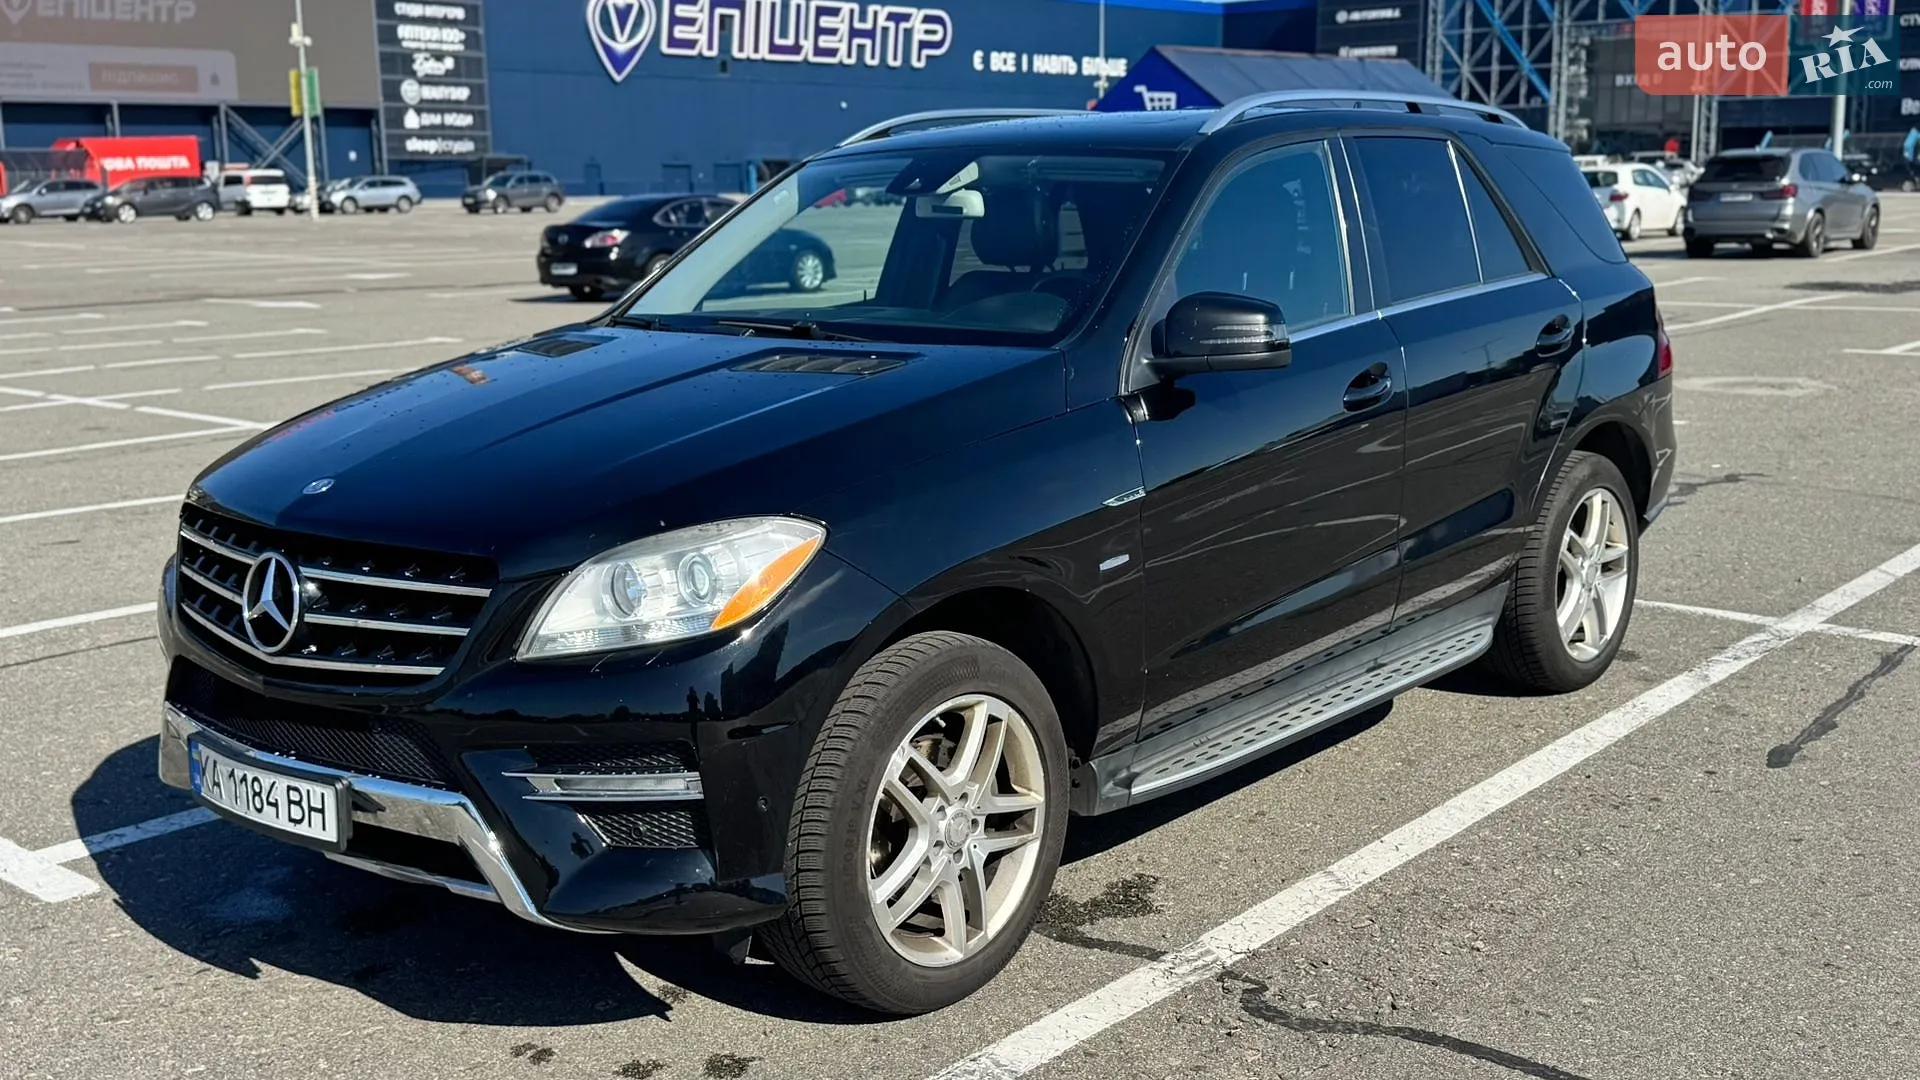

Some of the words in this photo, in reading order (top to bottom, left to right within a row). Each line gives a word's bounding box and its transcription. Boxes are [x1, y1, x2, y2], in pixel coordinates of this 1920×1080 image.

[36, 0, 198, 24] ЕПІЦЕНТР
[660, 0, 952, 68] ЕПІЦЕНТР
[990, 51, 1016, 73] ВСЕ
[1033, 54, 1078, 75] НАВІТЬ
[135, 155, 191, 171] ПОШТА
[228, 767, 280, 819] 1184
[286, 784, 327, 832] BH
